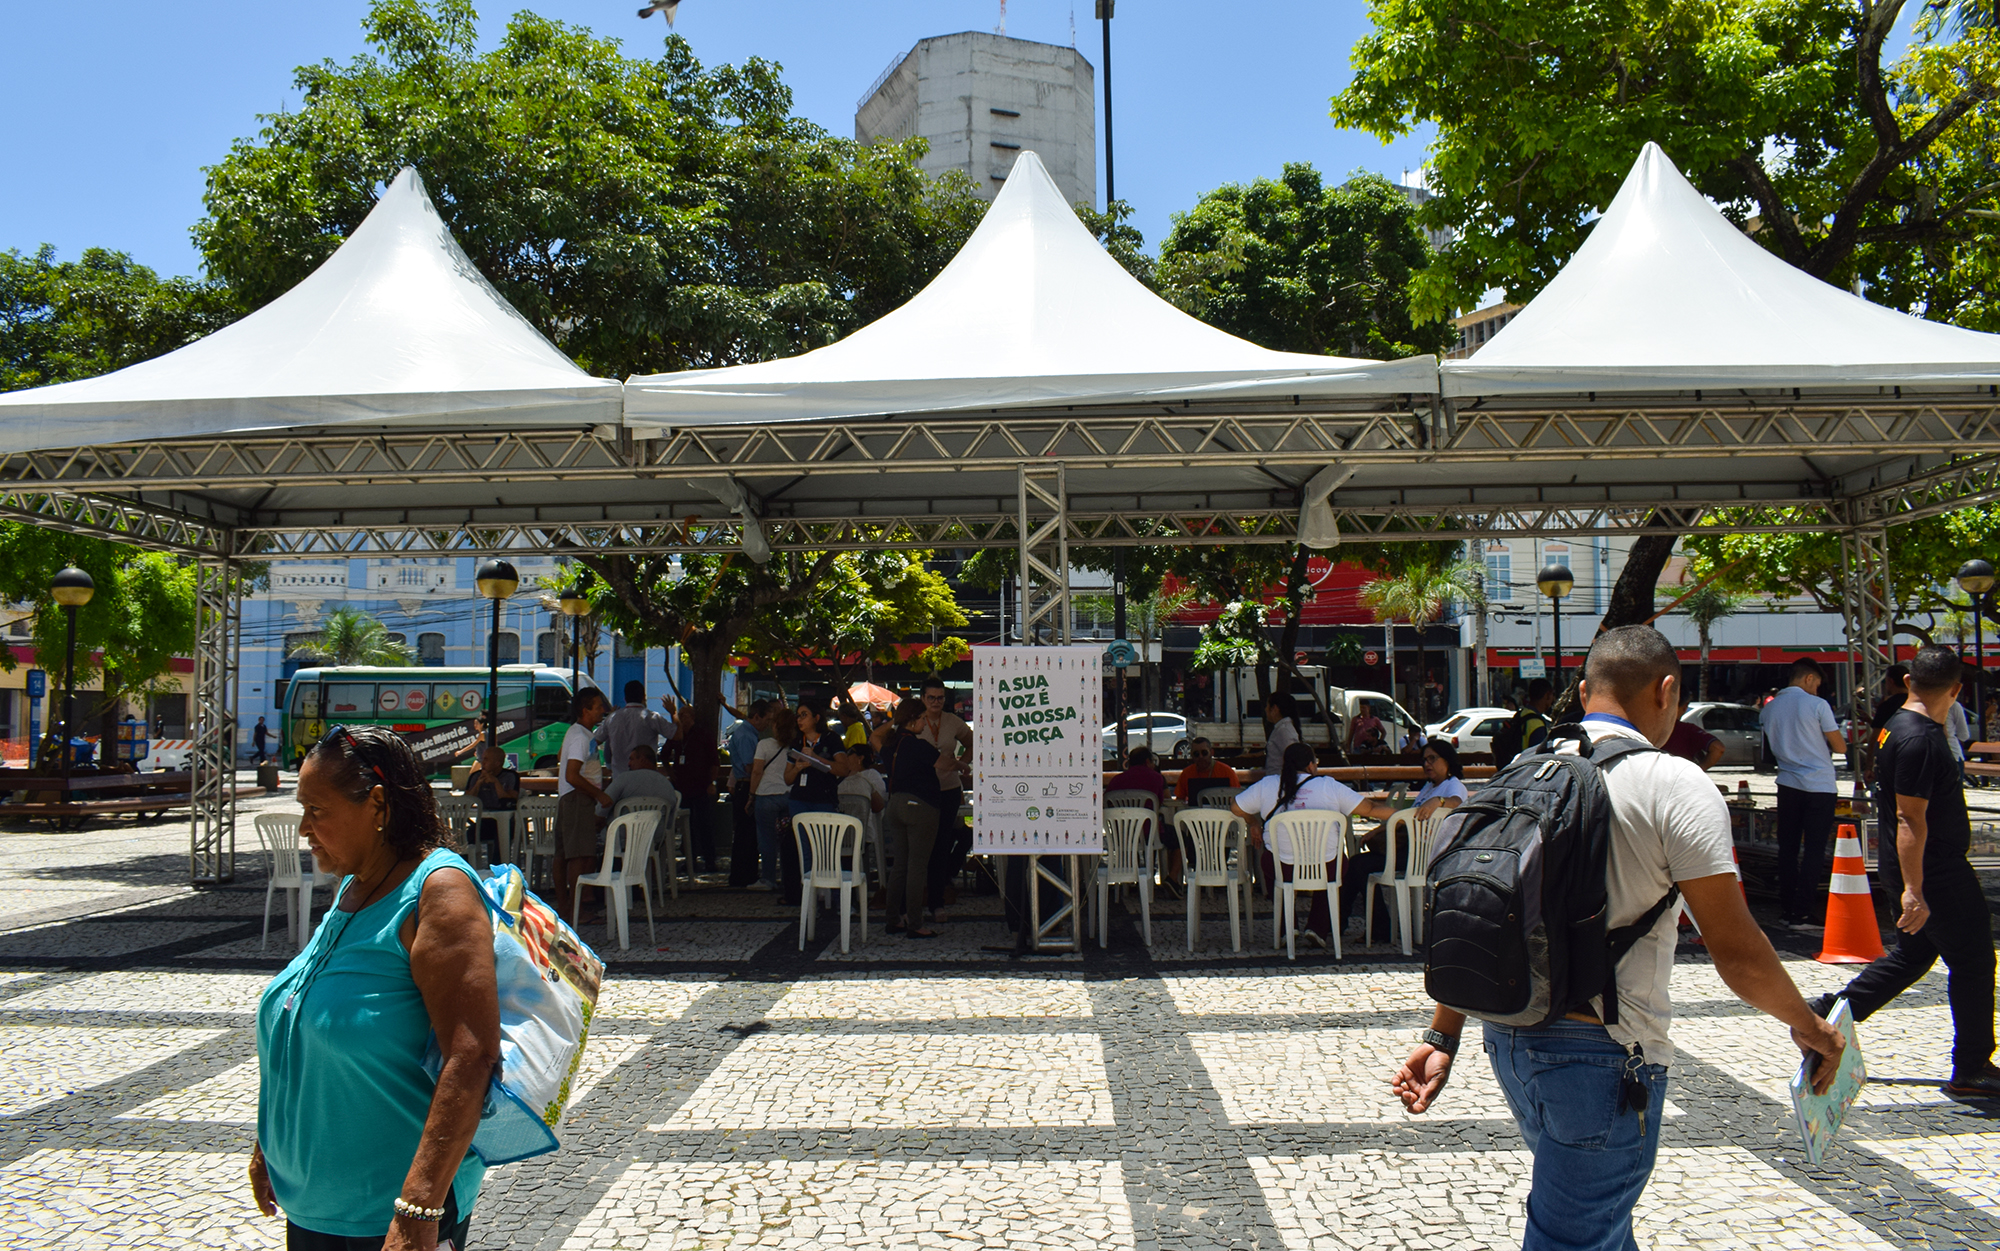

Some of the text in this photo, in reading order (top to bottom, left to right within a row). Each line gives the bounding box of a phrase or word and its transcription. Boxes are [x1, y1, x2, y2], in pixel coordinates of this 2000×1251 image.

[998, 674, 1049, 693] A SUA
[998, 689, 1050, 711] VOZ É
[1001, 706, 1077, 729] A NOSSA
[411, 725, 468, 753] idade Móvel de
[421, 741, 458, 760] Educação
[496, 721, 515, 734] nsito
[1003, 726, 1064, 746] FORÇA
